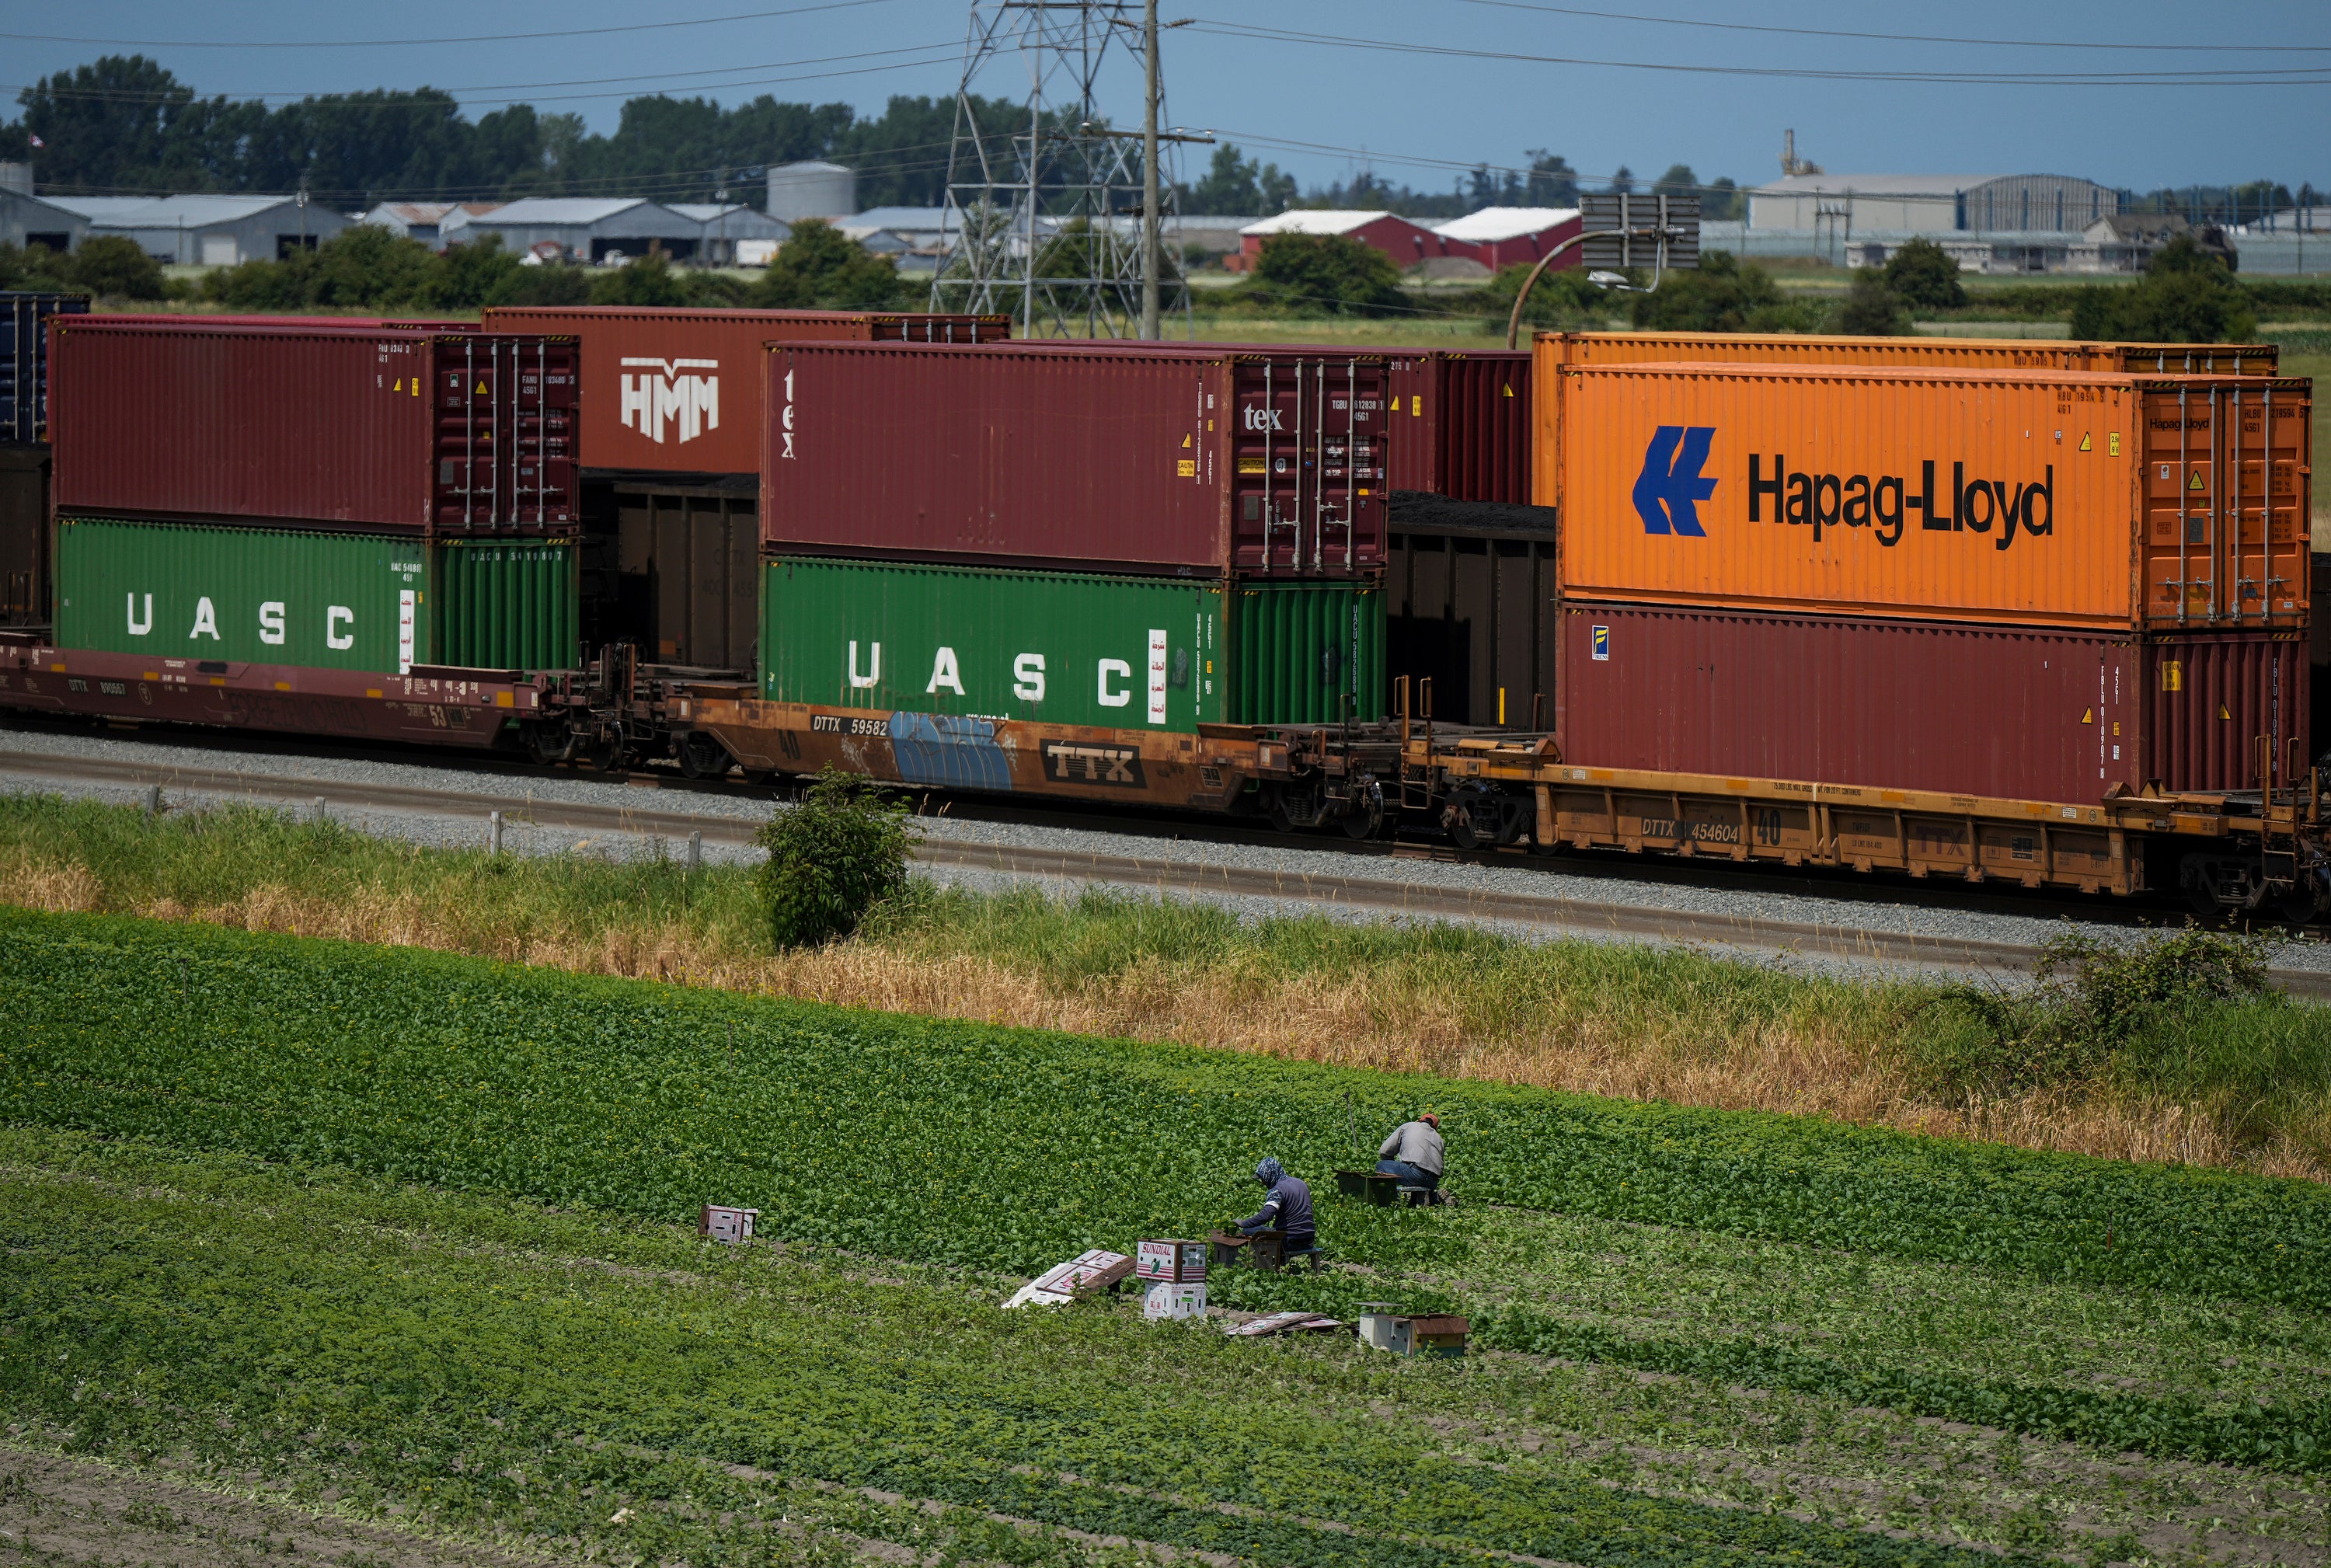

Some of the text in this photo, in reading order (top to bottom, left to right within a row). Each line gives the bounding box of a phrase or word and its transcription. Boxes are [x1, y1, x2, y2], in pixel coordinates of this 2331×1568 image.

[522, 375, 537, 384] FANU
[621, 357, 718, 444] HMM
[1332, 400, 1347, 410] TGBU
[1243, 402, 1283, 430] tex
[2150, 418, 2209, 431] HapagLloyd
[2245, 409, 2305, 418] HLBU 219594 5
[2244, 423, 2260, 432] 45G1
[1748, 453, 2054, 551] Hapag-Lloyd
[471, 552, 502, 561] UACU
[127, 592, 354, 650] UASC
[848, 640, 1131, 708] UASC
[429, 705, 448, 727] 53
[814, 715, 887, 737] DTTX 59582
[777, 730, 800, 761] 40
[1047, 744, 1134, 782] TTX
[1642, 820, 1739, 842] DTTX 454604
[1758, 808, 1781, 845] 40
[1916, 826, 1965, 856] TTX
[1142, 1243, 1170, 1256] SUNDIAL
